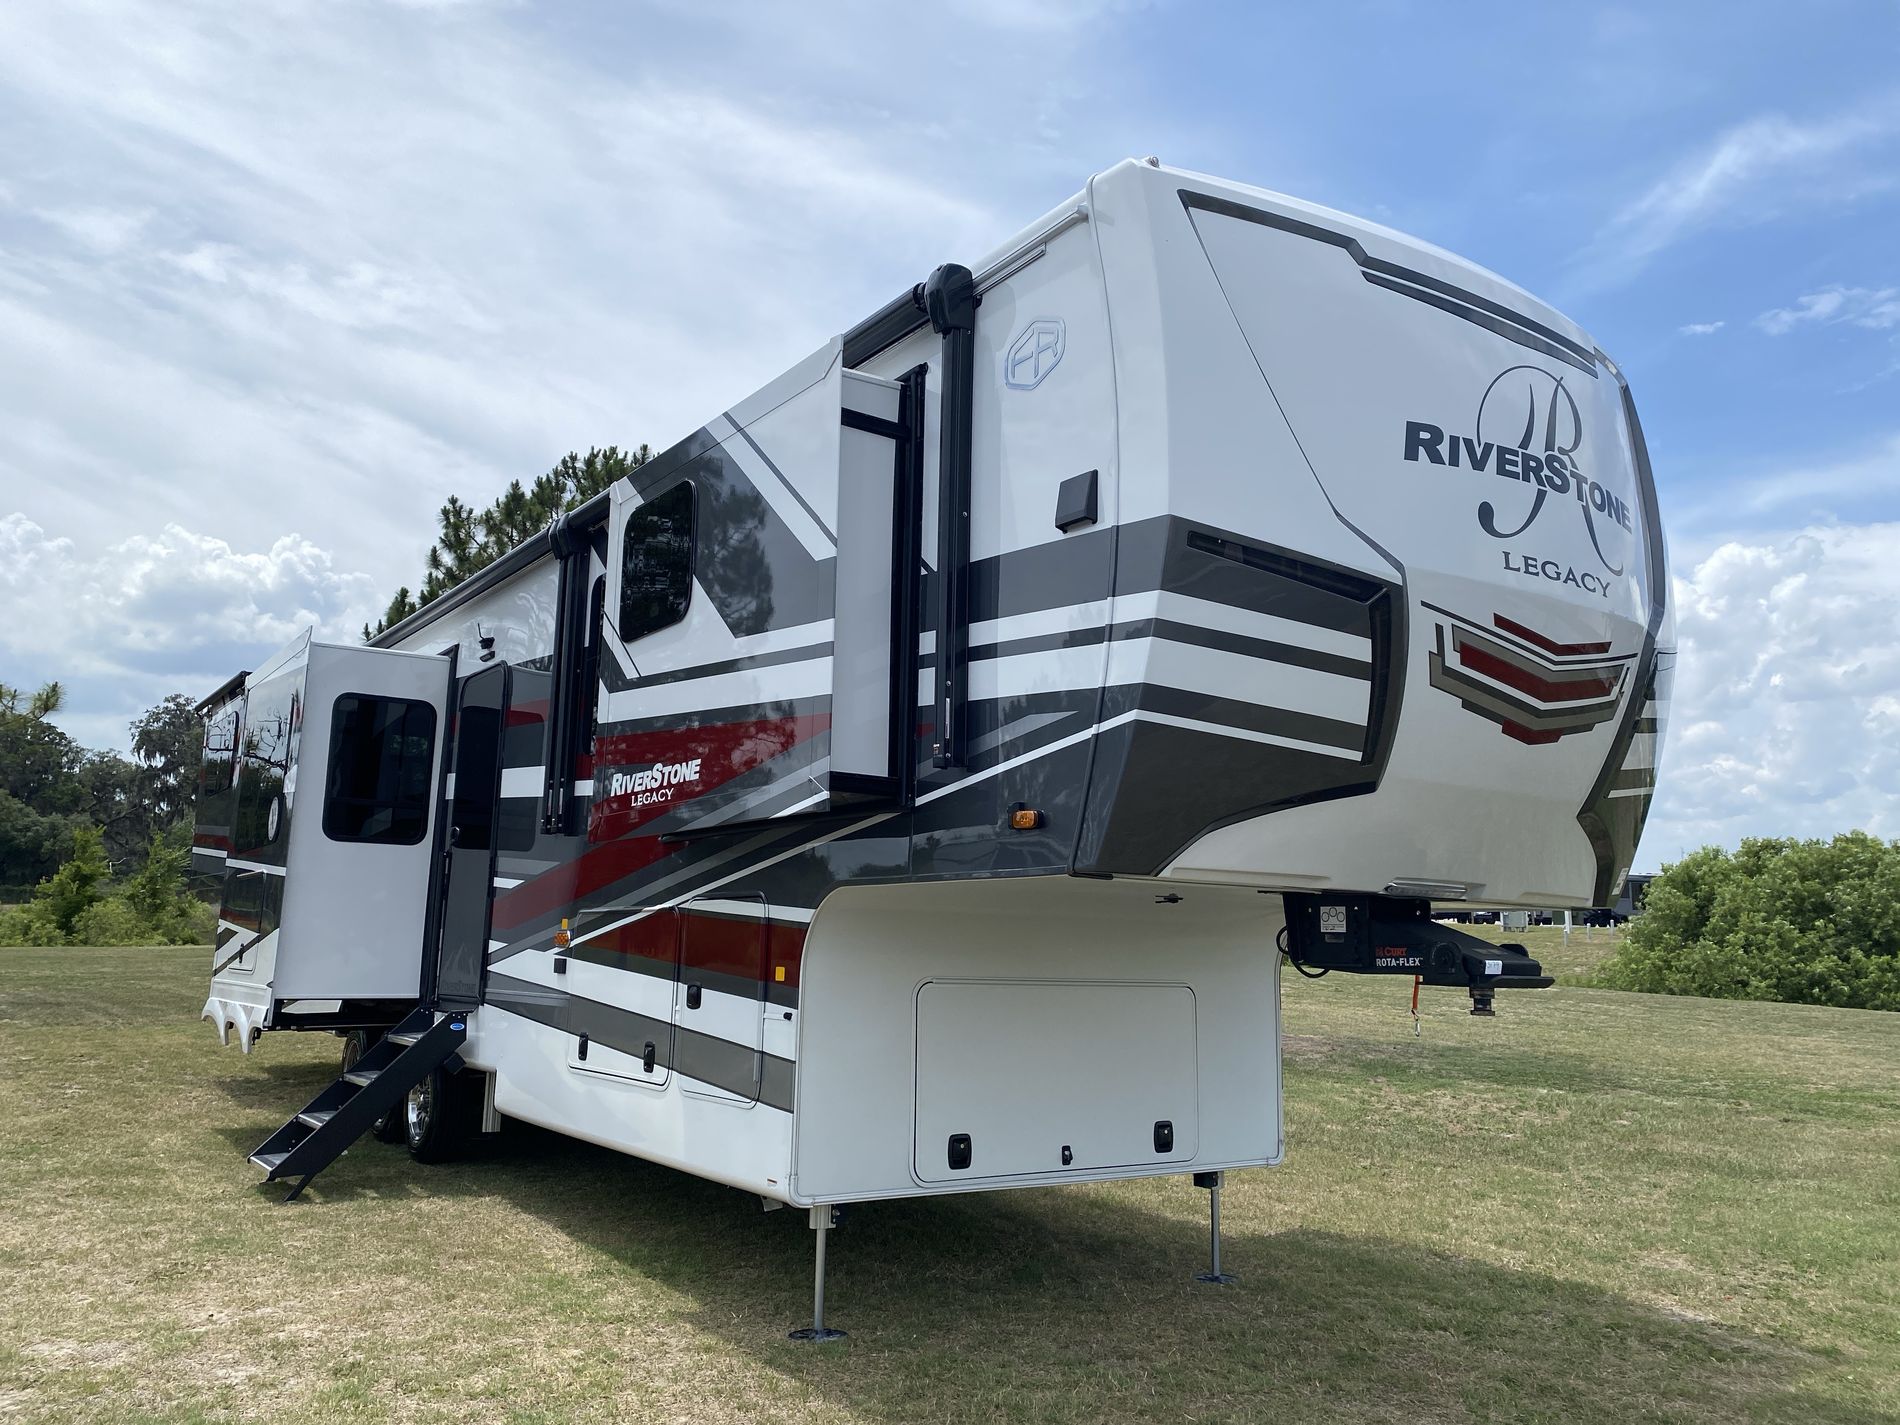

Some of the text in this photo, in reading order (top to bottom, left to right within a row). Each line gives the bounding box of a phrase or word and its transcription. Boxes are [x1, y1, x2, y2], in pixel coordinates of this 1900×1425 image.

[1404, 421, 1632, 534] RIVERSTONE
[1502, 551, 1610, 597] LEGACY
[610, 758, 701, 797] RIVERSTONE
[631, 788, 674, 806] LEGACY
